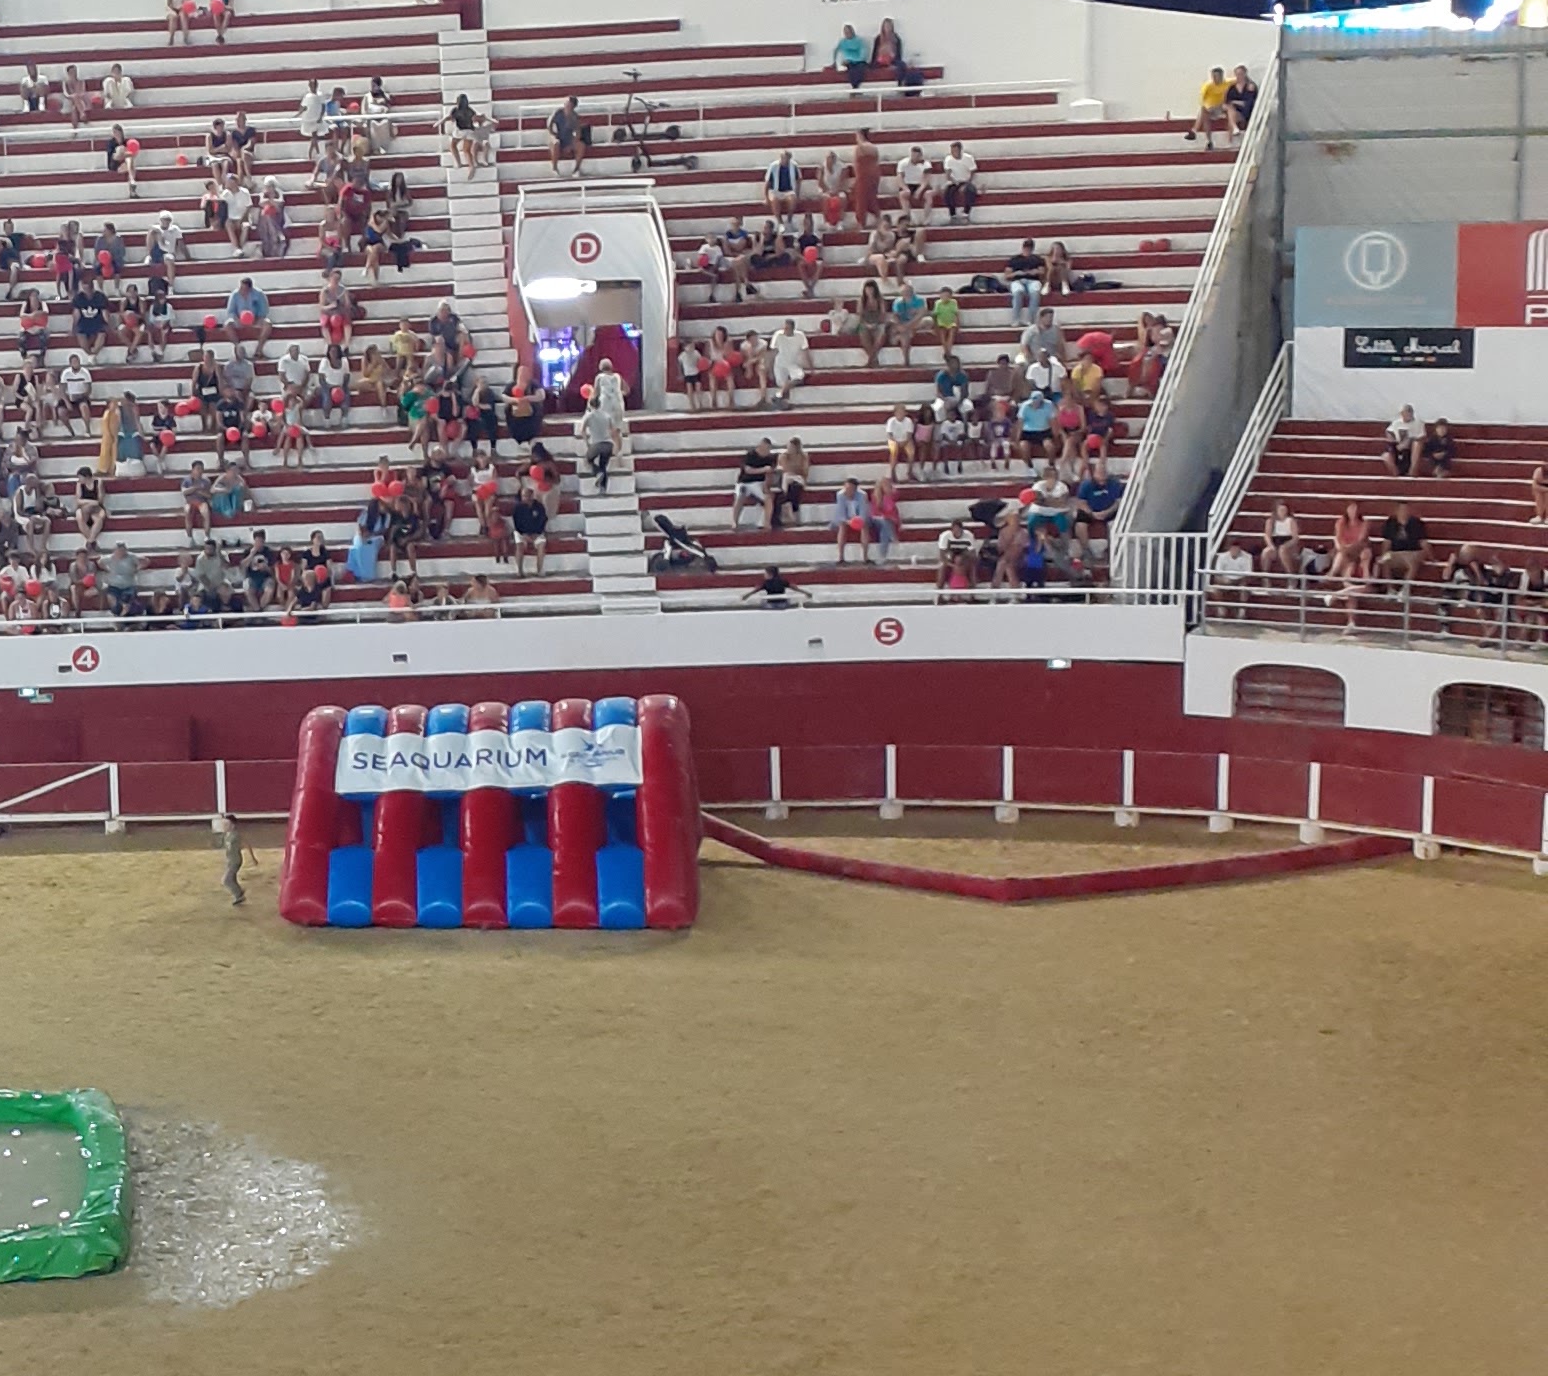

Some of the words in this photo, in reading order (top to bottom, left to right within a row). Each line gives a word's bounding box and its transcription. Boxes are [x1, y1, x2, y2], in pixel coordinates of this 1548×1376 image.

[575, 237, 599, 259] D
[878, 620, 900, 642] 5
[75, 648, 97, 670] 4
[351, 747, 548, 771] SEAQUARIUM
